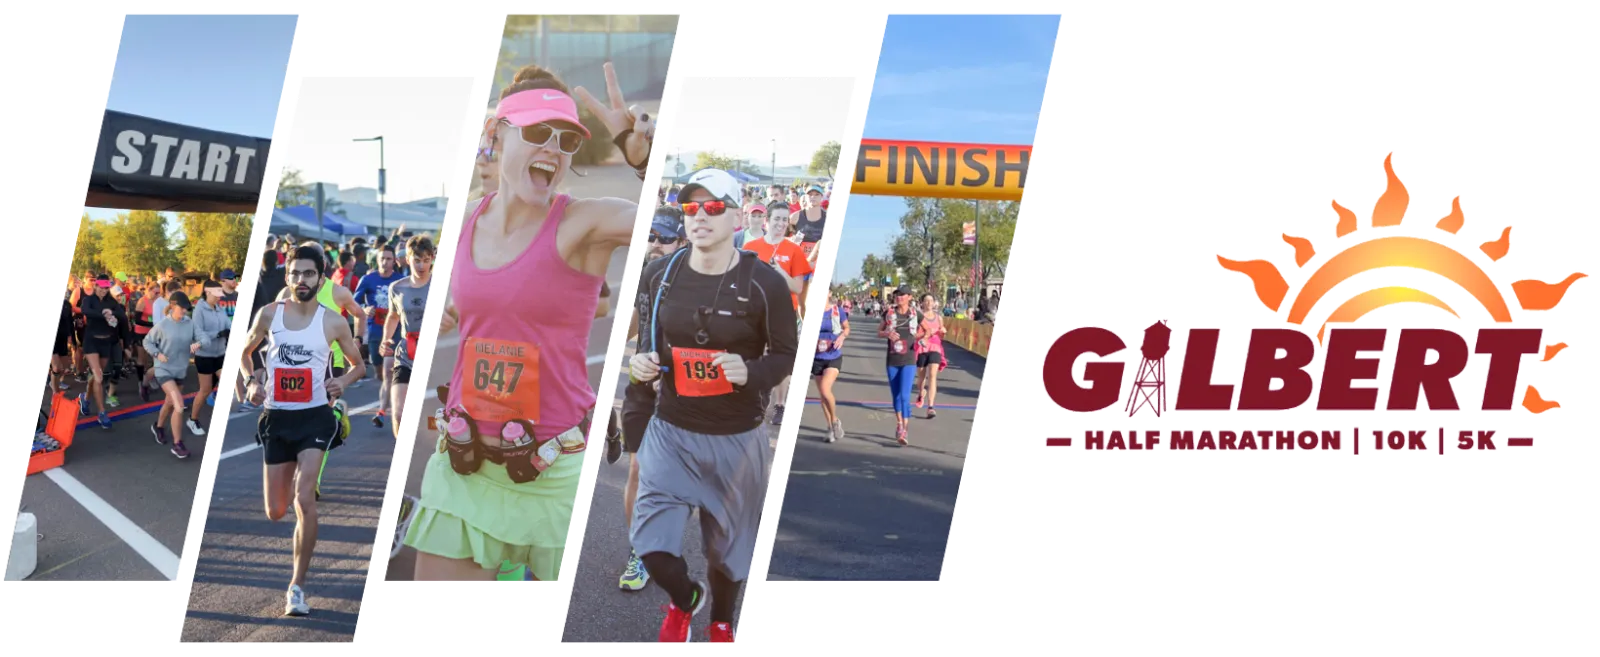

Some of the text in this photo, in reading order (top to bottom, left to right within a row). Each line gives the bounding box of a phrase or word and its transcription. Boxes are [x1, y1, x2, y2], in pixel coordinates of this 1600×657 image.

[110, 129, 257, 185] START
[855, 144, 1030, 188] FINISH
[475, 342, 525, 358] MELANIE
[280, 375, 306, 391] 602
[475, 359, 524, 393] 647
[682, 360, 719, 380] 193
